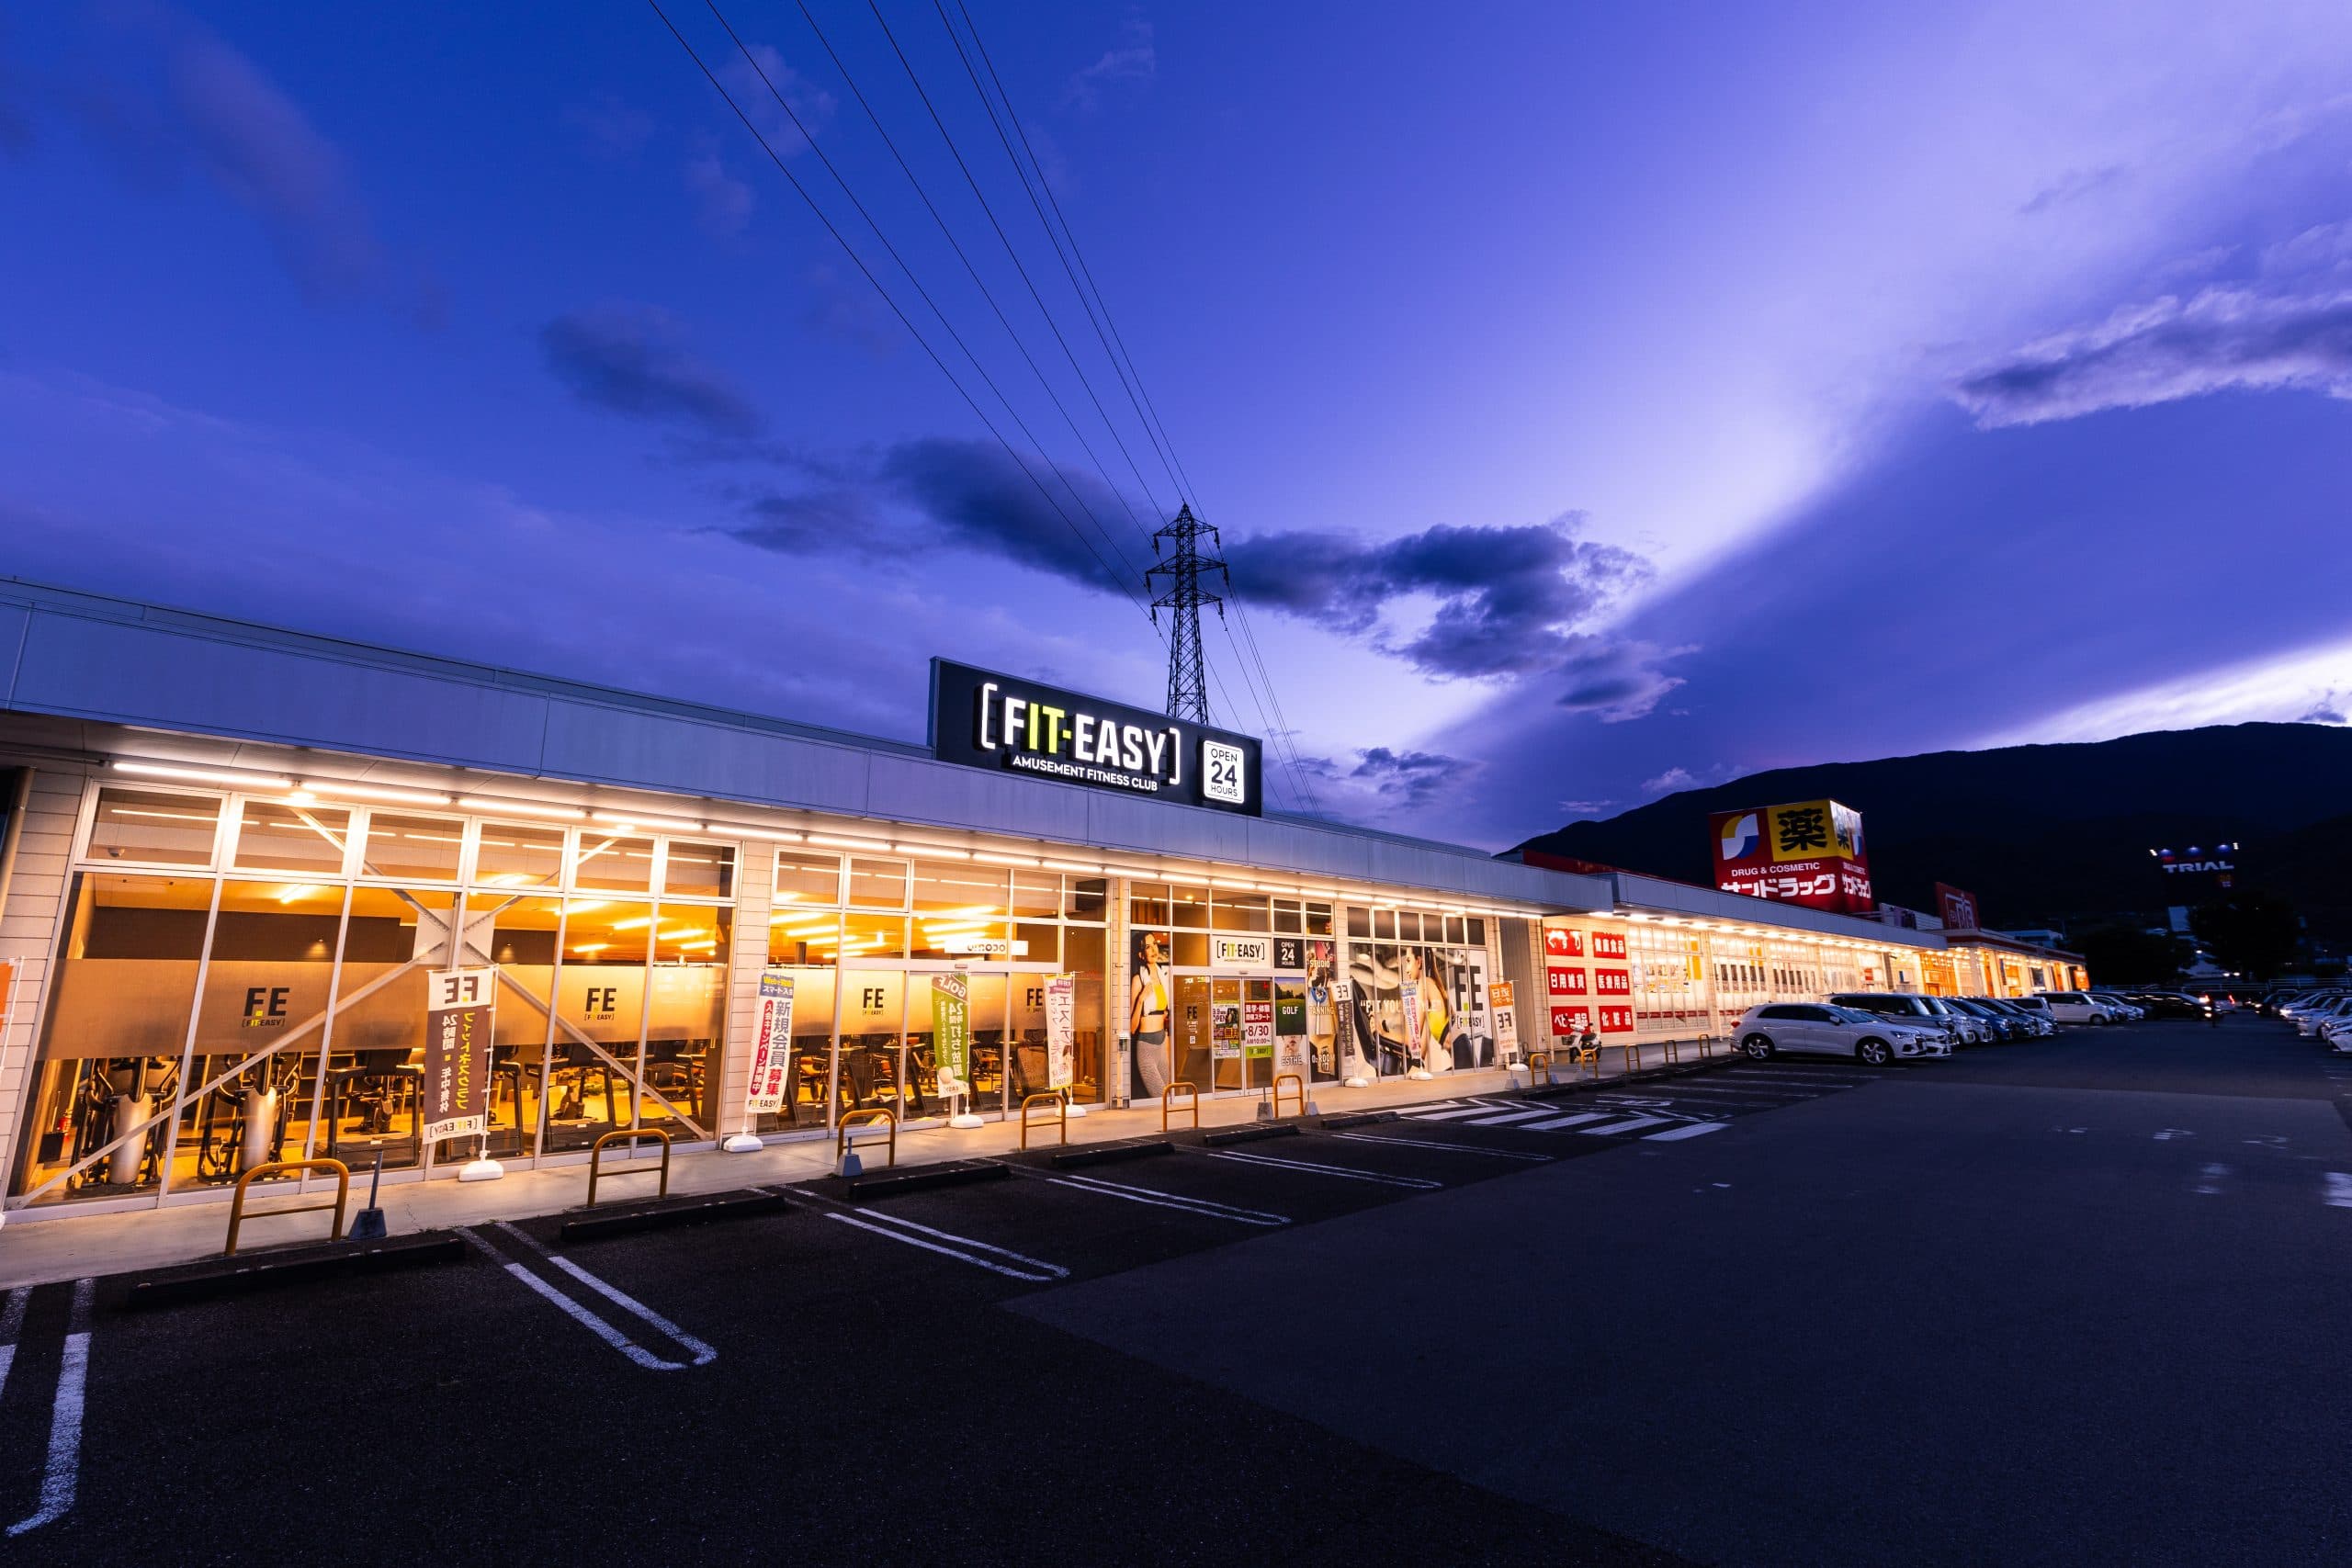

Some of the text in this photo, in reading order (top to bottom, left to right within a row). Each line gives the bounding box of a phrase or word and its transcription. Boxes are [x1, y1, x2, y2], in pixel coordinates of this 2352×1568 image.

[1210, 748, 1238, 762] OPEN
[1012, 755, 1159, 792] AMUSEMENT FITNESS CLUB
[1210, 761, 1238, 788] 24
[1210, 784, 1238, 798] HOURS
[1777, 807, 1828, 852] 薬
[1731, 862, 1821, 877] DRUG & COSMETIC
[2162, 860, 2235, 874] TRIAL
[1721, 874, 1837, 898] サンドラッグ
[1281, 947, 1295, 961] 24
[1309, 959, 1330, 968] STUDIO
[1550, 974, 1585, 989] 日用雑貨
[1597, 975, 1629, 990] 医療用品
[1282, 1006, 1299, 1015] GOLF
[1601, 1011, 1633, 1027] 化粧品
[1248, 1025, 1269, 1036] 8/30
[764, 1000, 791, 1096] 新規会員募集
[1281, 1054, 1303, 1066] ESTHE
